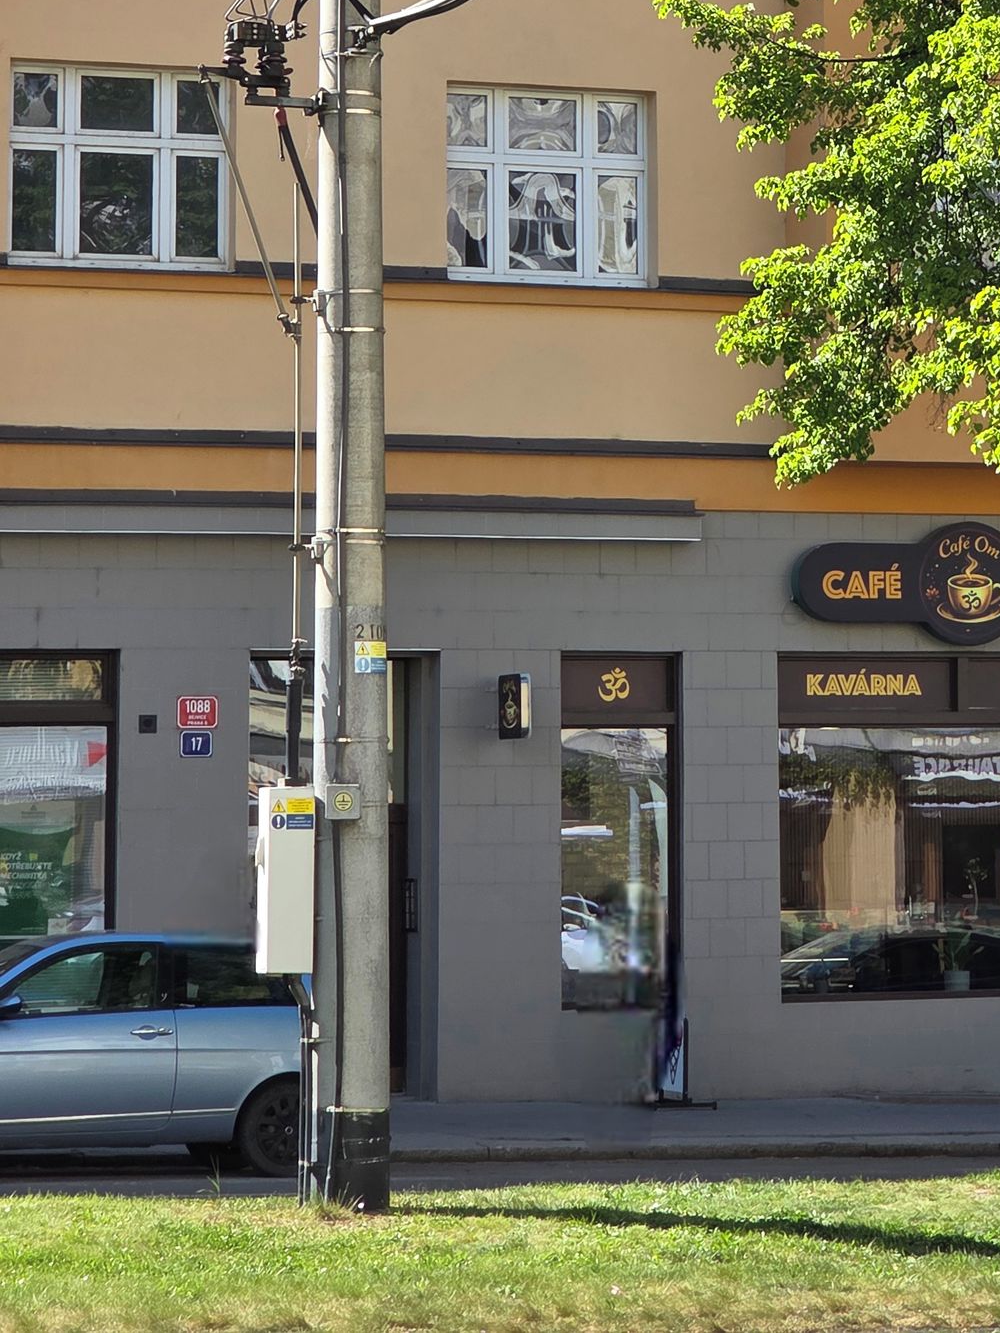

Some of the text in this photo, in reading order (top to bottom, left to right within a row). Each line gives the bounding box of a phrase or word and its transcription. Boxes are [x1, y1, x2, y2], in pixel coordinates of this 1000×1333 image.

[938, 534, 1000, 560] Café Om
[822, 563, 902, 600] CAFÉ
[805, 668, 922, 696] KAVÁRNA
[185, 699, 211, 713] 1088
[191, 737, 202, 751] 17
